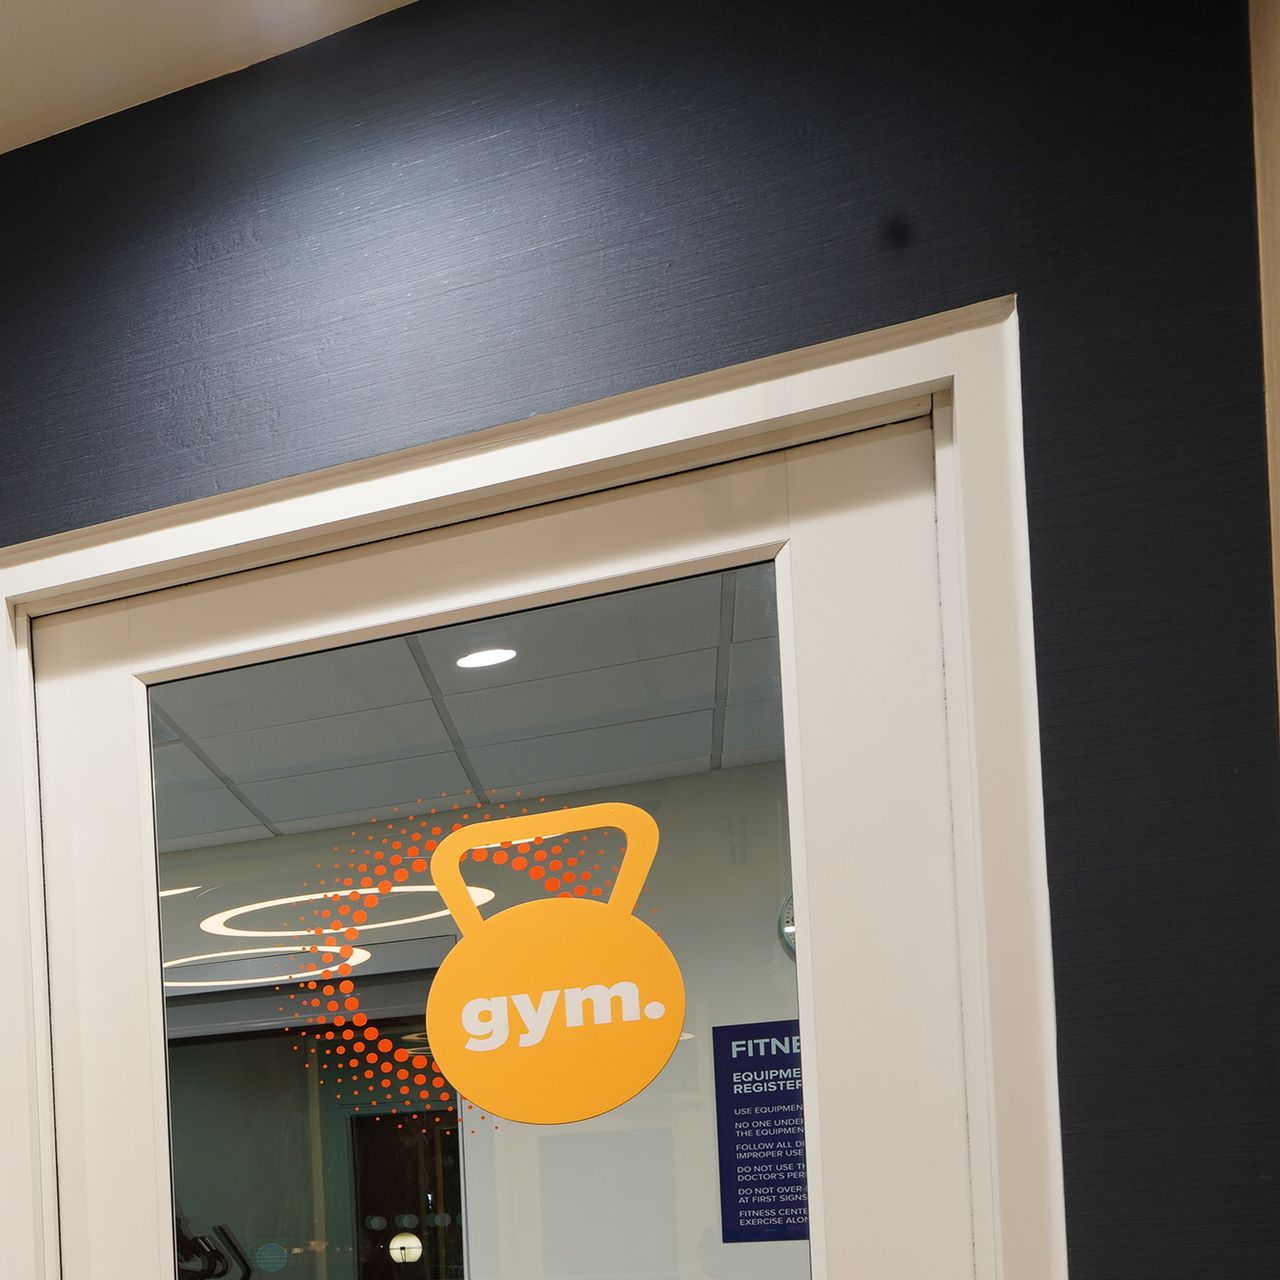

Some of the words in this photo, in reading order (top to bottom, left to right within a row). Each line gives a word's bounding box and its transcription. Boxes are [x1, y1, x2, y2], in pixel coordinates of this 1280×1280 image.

[460, 979, 667, 1053] gym.
[733, 1067, 802, 1083] EQUIPME
[734, 1107, 752, 1116] USE
[754, 1103, 803, 1114] EQUIPMEN
[734, 1121, 749, 1129] NO
[751, 1119, 772, 1128] ONE
[735, 1129, 753, 1137] THE
[755, 1126, 804, 1137] EQUIPMEN
[736, 1142, 774, 1151] FOLLOW
[776, 1141, 793, 1149] ALL
[736, 1150, 783, 1159] IMPROPER
[785, 1148, 804, 1157] USE
[737, 1165, 752, 1173] DO
[753, 1164, 773, 1172] NOT
[775, 1163, 795, 1171] USE
[737, 1172, 785, 1182] DOCTOR'S
[787, 1171, 807, 1179] PER
[738, 1187, 753, 1195] DO
[754, 1186, 774, 1194] NOT
[738, 1196, 750, 1204] AT
[752, 1195, 776, 1203] FIRST
[779, 1193, 807, 1202] SIGNS
[739, 1209, 776, 1217] FITNESS
[739, 1217, 783, 1226] EXERCISE
